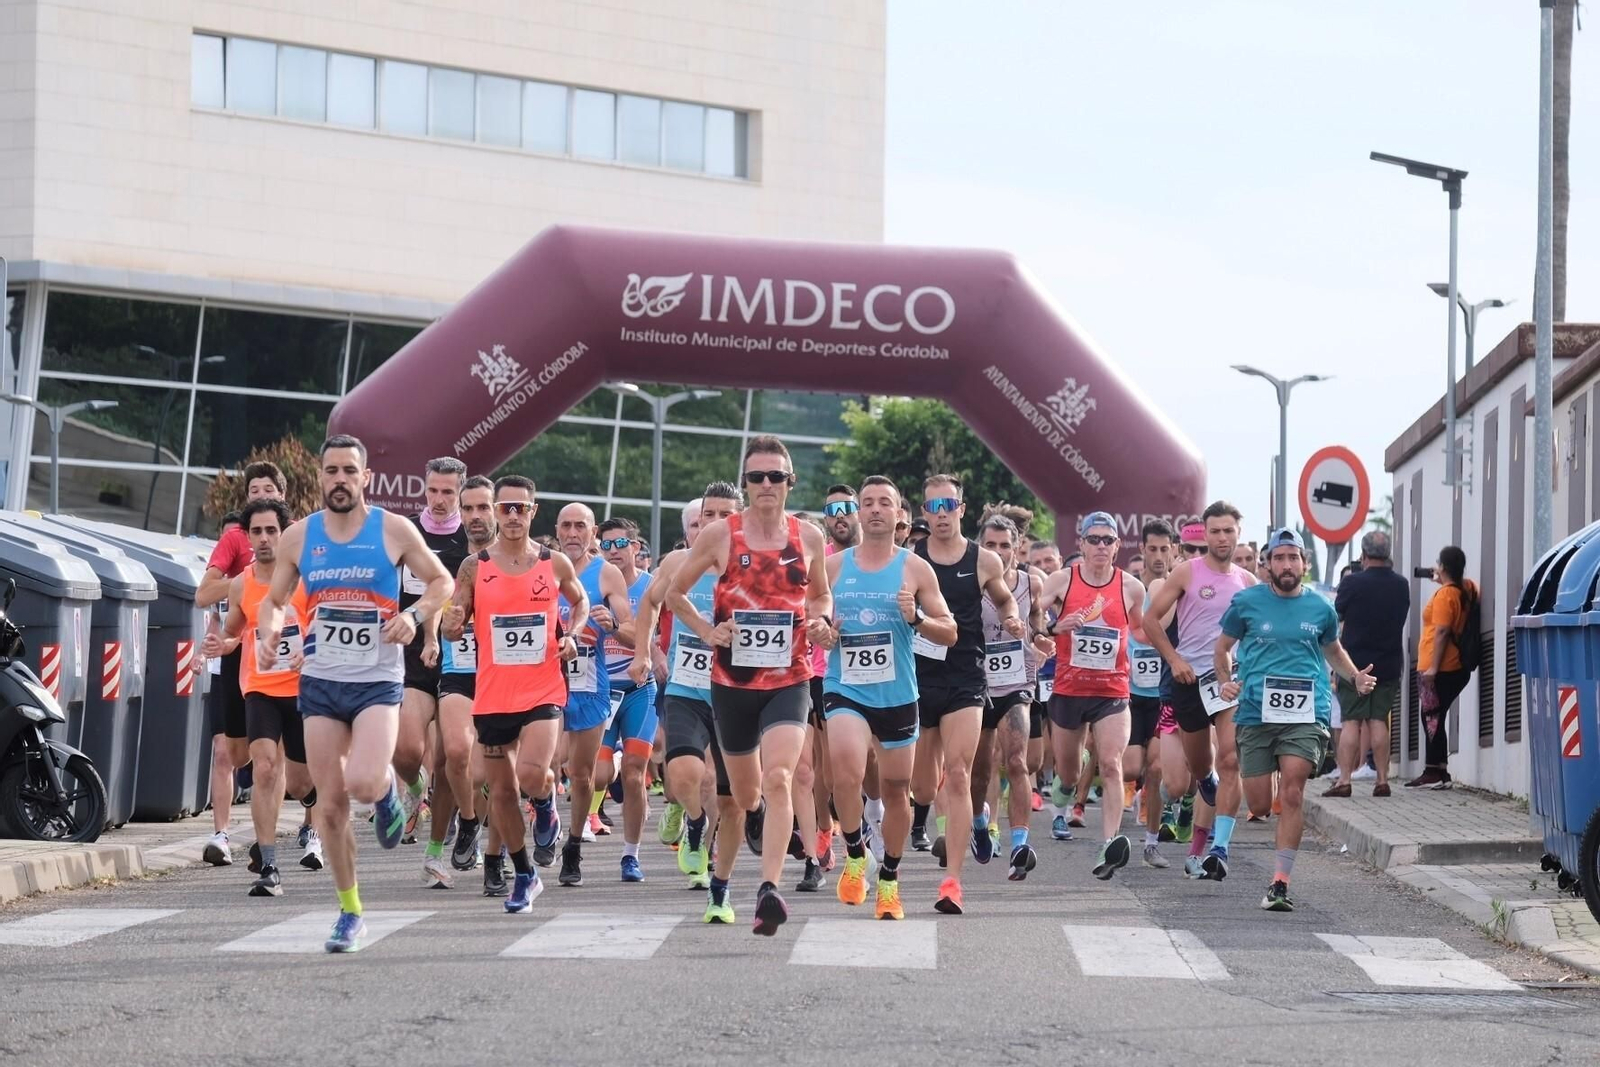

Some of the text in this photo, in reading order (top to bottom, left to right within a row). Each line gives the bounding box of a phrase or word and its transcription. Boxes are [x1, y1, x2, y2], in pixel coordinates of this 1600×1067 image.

[700, 274, 956, 335] IMDECO
[620, 327, 950, 360] Instituto Municipal de Deportes Córdoba
[453, 341, 589, 457] AYUNTAMIENTO DE CÓRDOBA
[982, 364, 1106, 493] AYUNTAMIENTO DE CÓRDOBA
[308, 565, 377, 582] enerplus
[323, 624, 371, 646] 706
[505, 630, 535, 648] 94
[739, 628, 786, 648] 394
[1077, 638, 1113, 655] 259
[846, 648, 887, 668] 786
[988, 655, 1013, 672] 89
[1137, 660, 1159, 674] 93
[1269, 692, 1308, 709] 887
